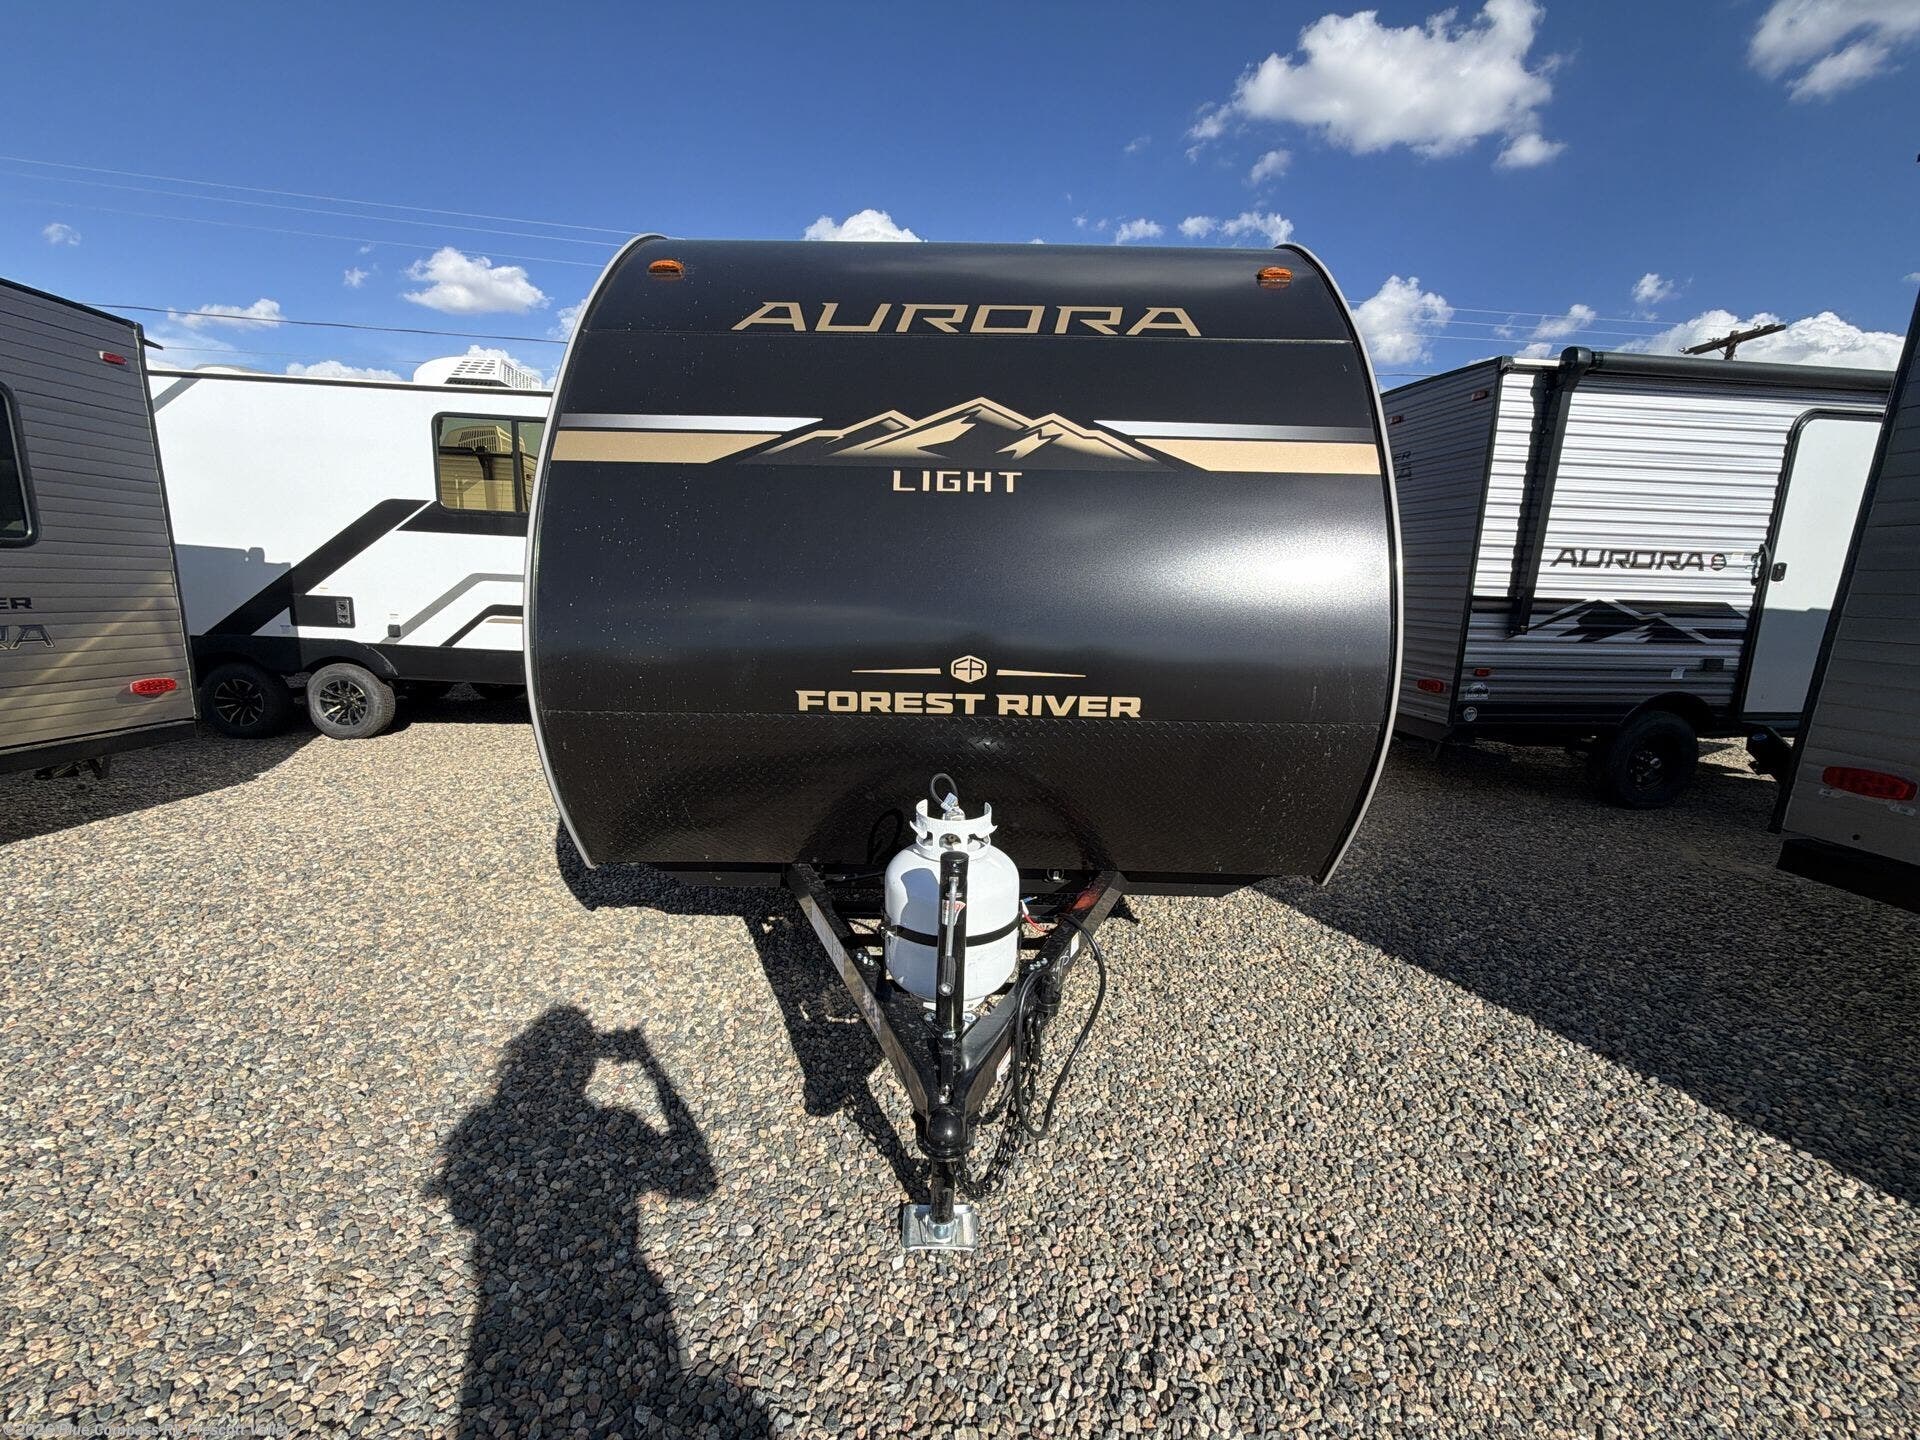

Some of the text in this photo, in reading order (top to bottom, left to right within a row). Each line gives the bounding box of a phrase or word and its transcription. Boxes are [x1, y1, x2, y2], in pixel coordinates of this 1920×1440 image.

[731, 301, 1202, 337] AURORA
[892, 469, 1023, 493] LIGHT
[1550, 548, 1704, 571] AURORA
[795, 690, 1142, 718] FOREST RIVER
